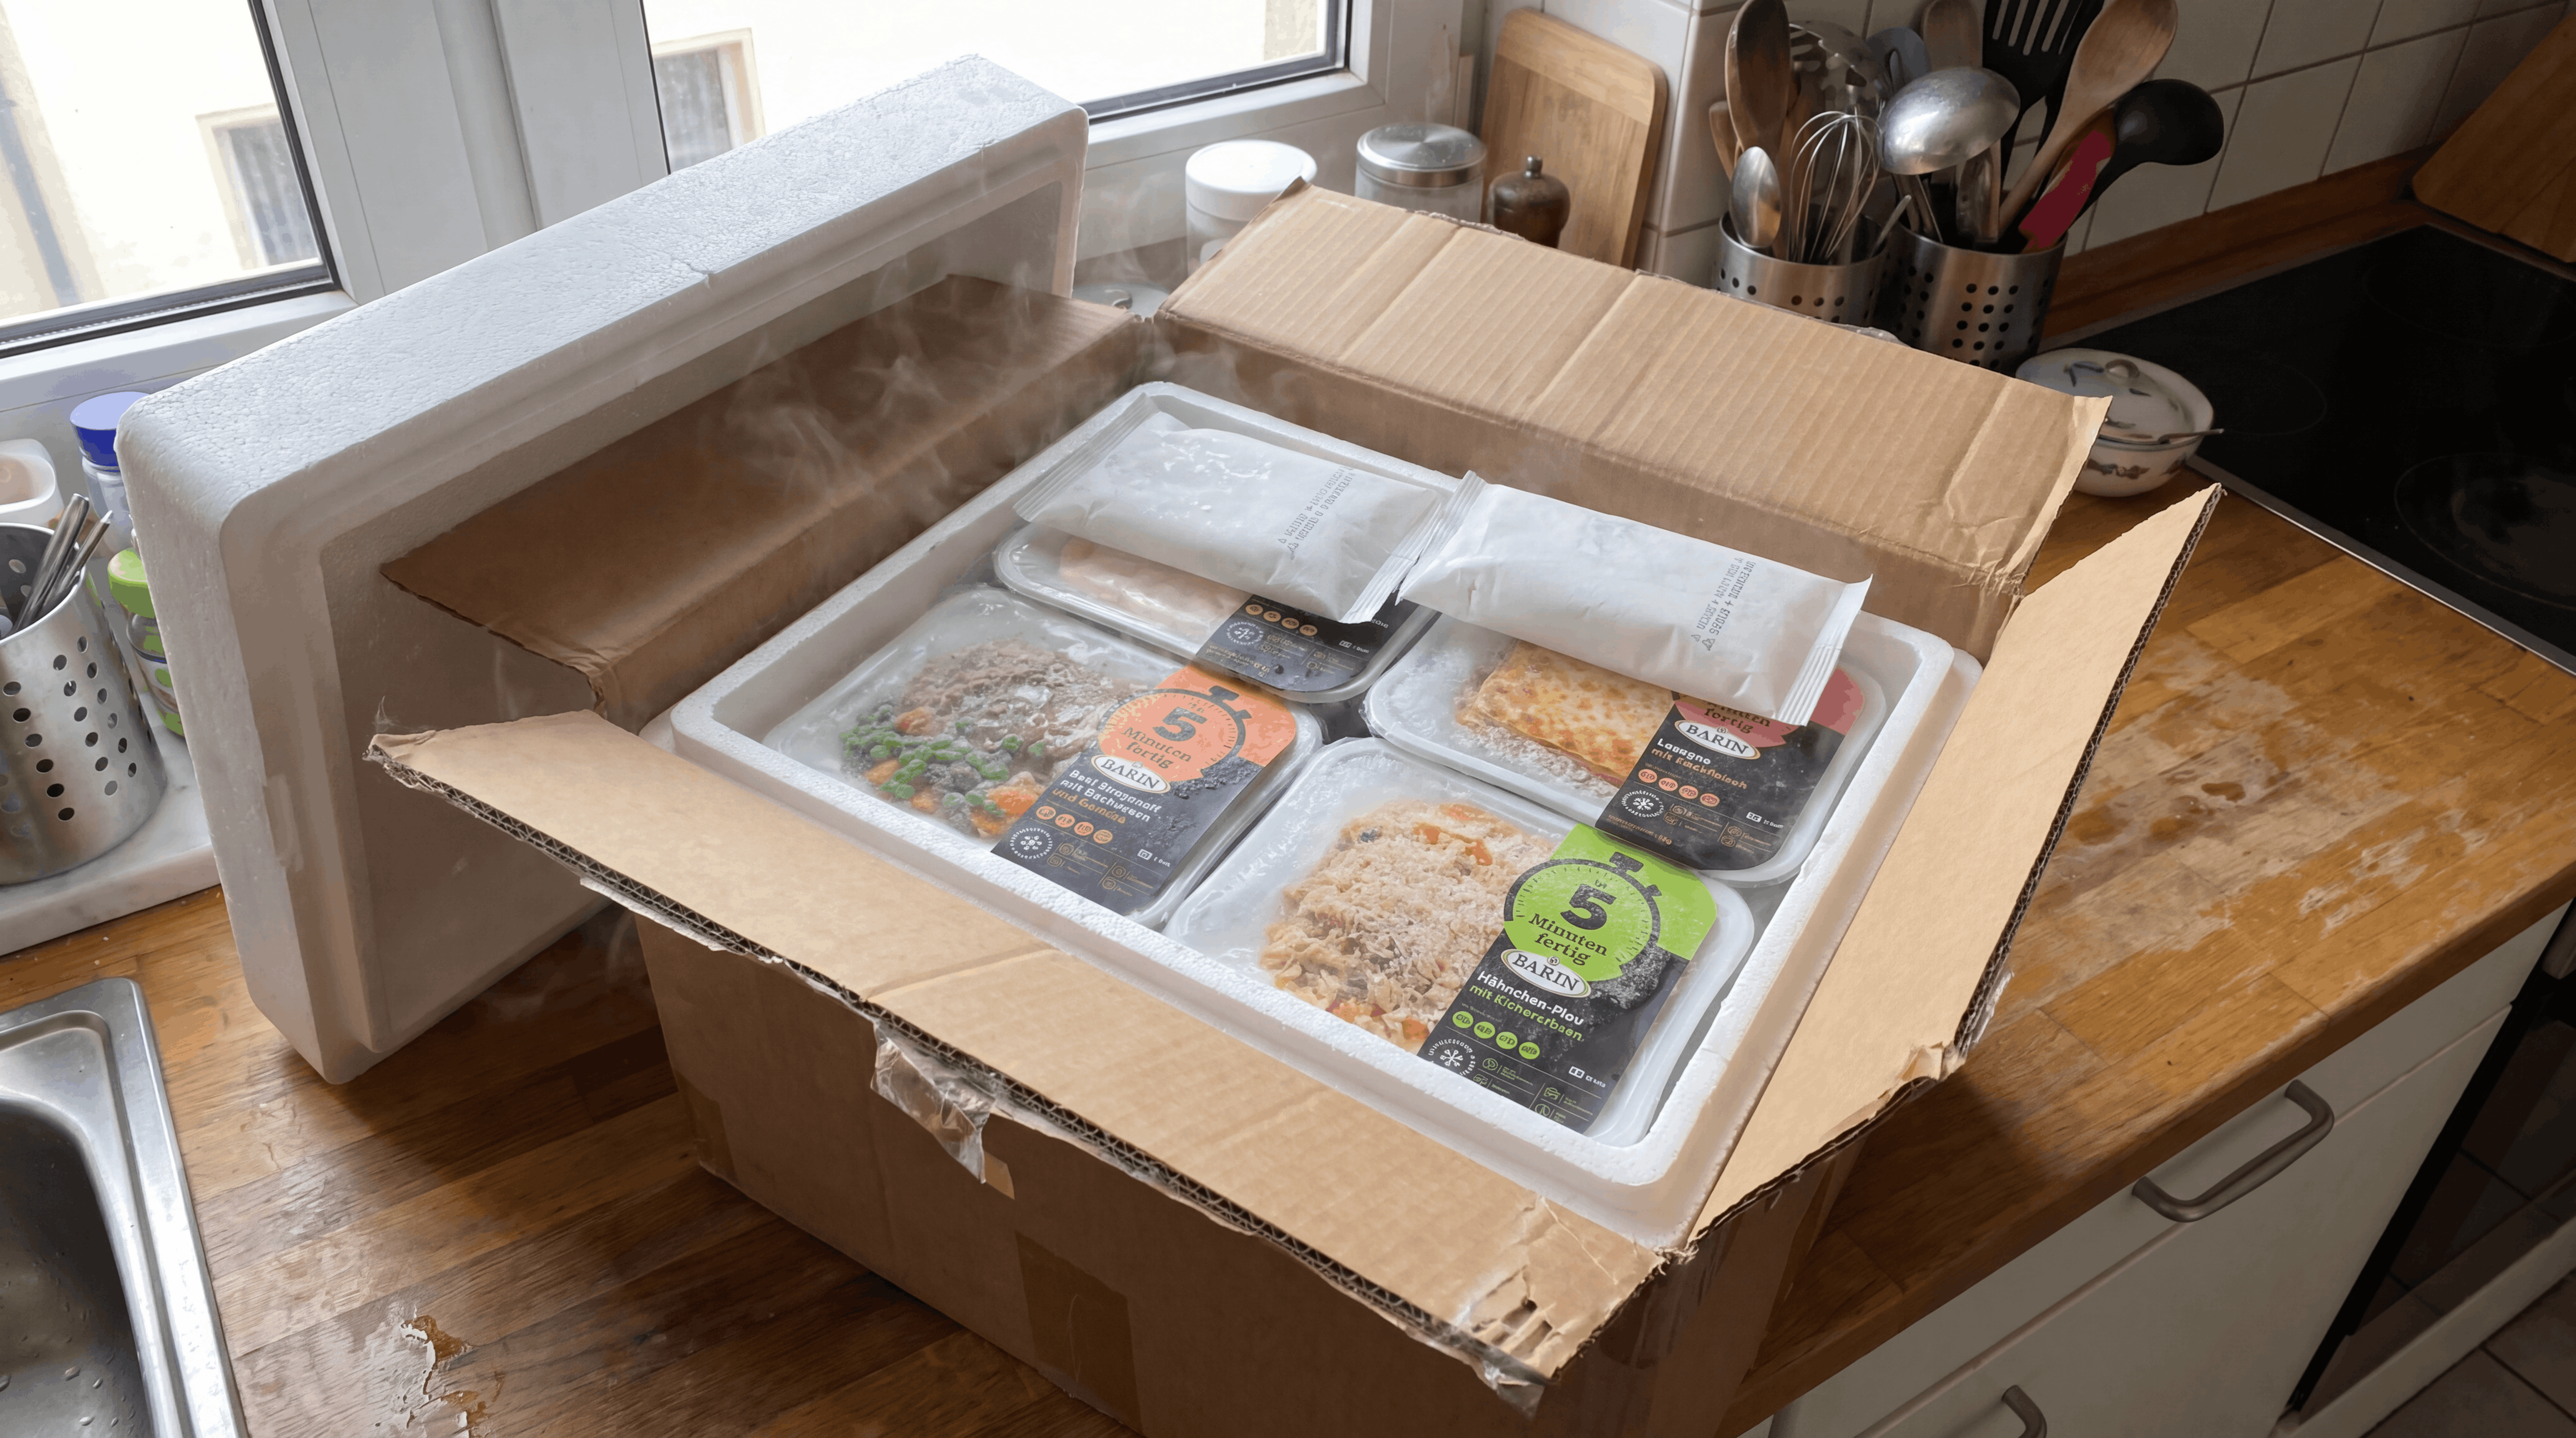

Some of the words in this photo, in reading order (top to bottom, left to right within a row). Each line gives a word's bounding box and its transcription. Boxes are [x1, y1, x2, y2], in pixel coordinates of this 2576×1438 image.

[1152, 707, 1208, 741] 5
[1686, 725, 1749, 755] BARIN
[1101, 759, 1160, 789] BARIN
[1560, 883, 1617, 930] 5
[1534, 933, 1591, 966] fertig
[1512, 954, 1580, 991] BARIN
